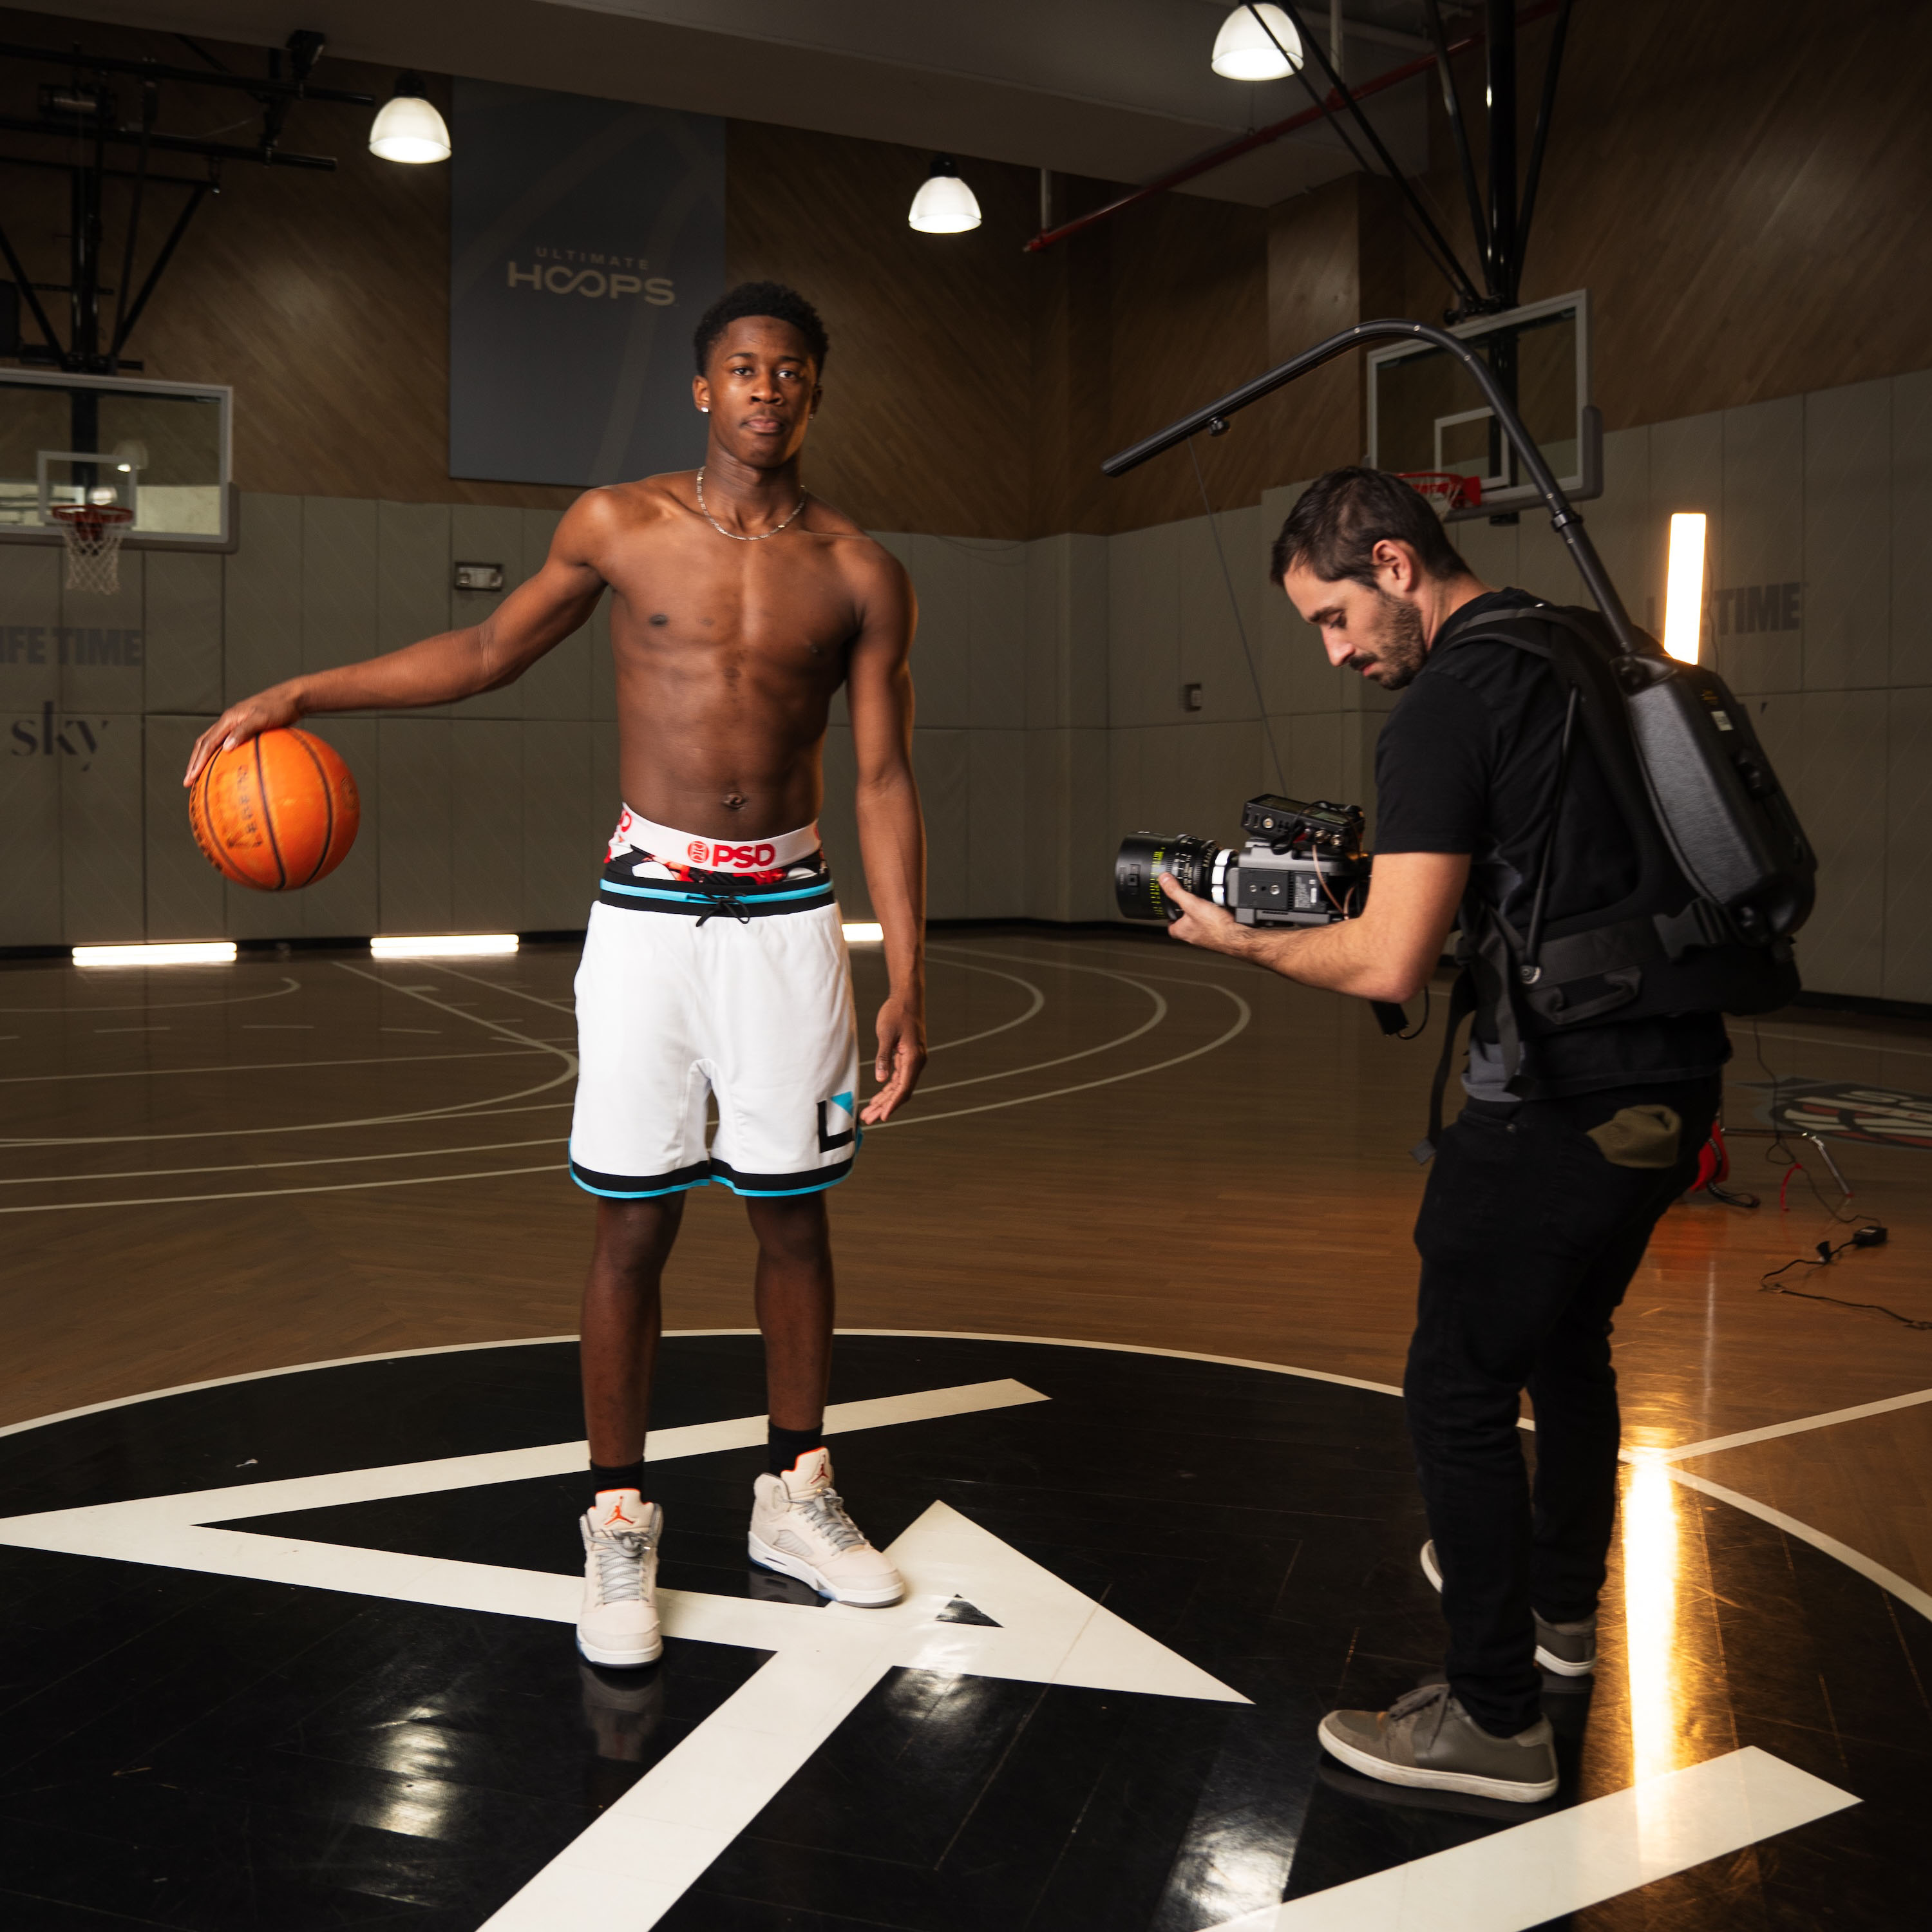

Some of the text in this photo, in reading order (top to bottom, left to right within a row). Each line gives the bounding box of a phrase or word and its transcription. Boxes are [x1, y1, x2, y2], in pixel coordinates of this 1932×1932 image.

[535, 246, 650, 270] ULTIMATE
[507, 260, 676, 306] HOOPS
[1714, 582, 1801, 636] TIME
[0, 627, 143, 666] IFE TIME
[12, 700, 109, 772] sky
[712, 844, 775, 868] PSD
